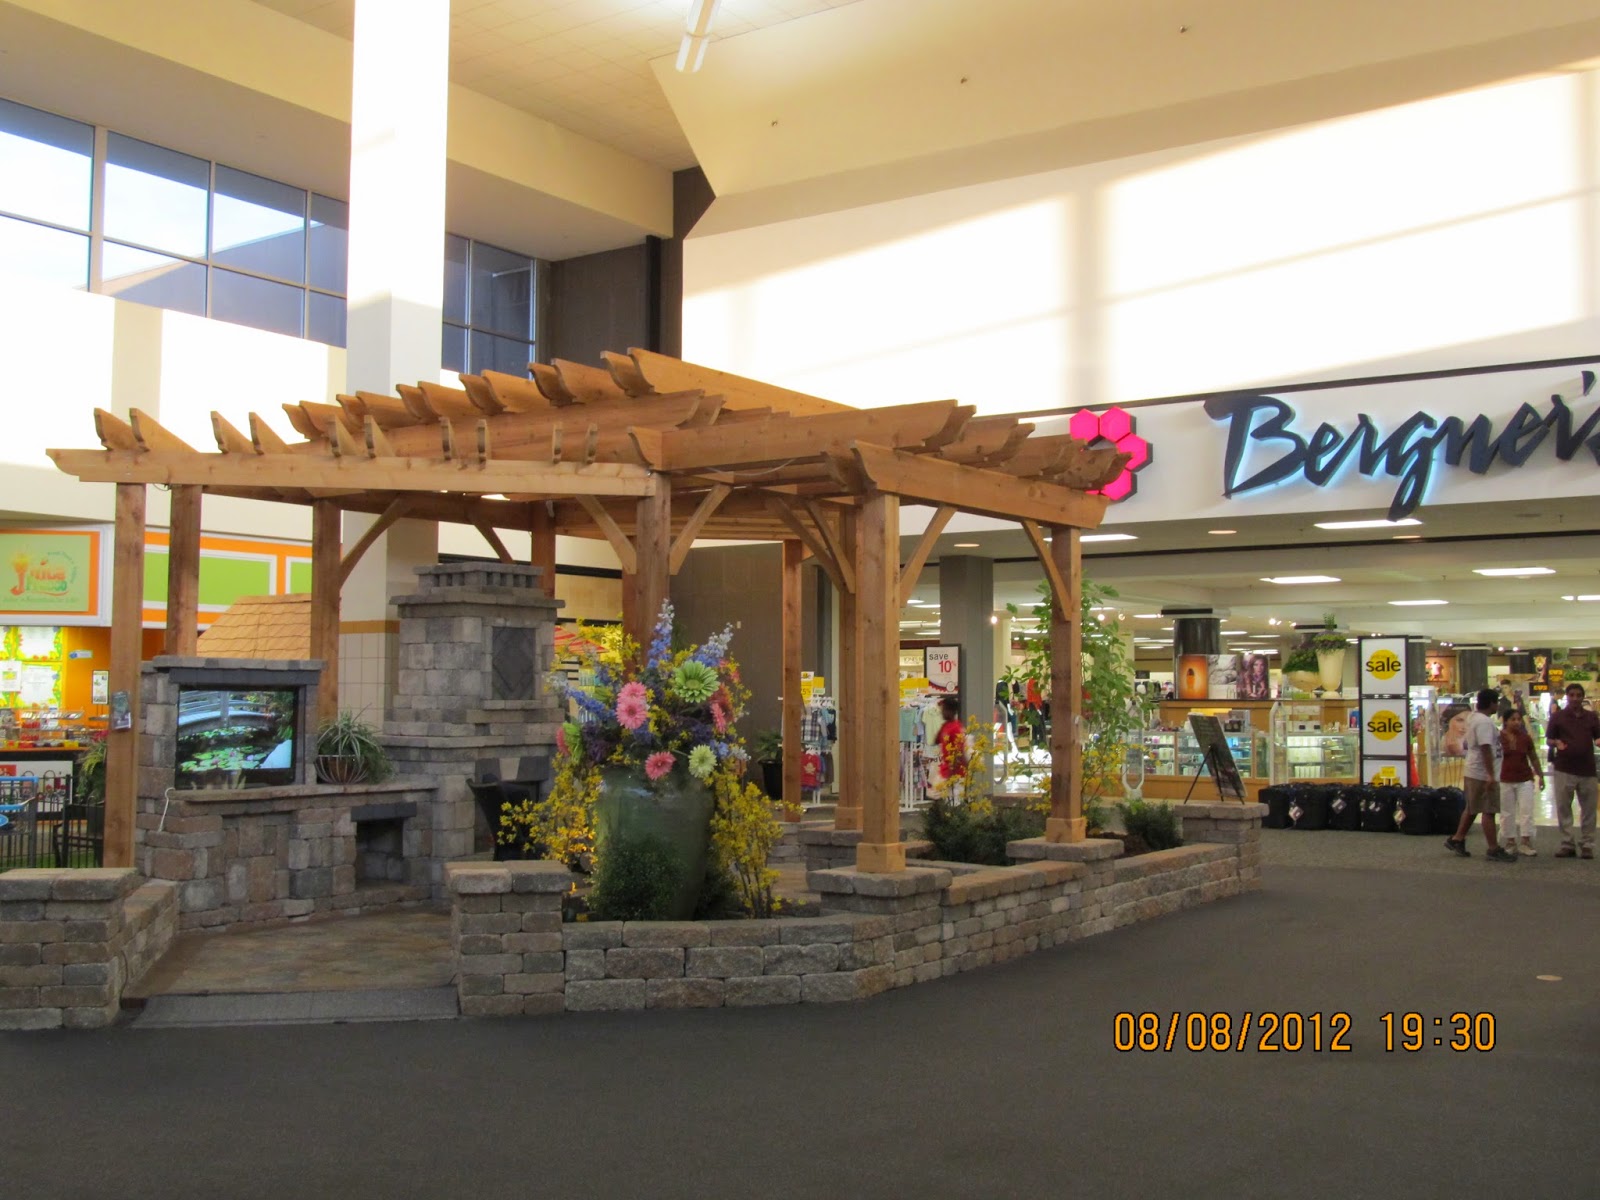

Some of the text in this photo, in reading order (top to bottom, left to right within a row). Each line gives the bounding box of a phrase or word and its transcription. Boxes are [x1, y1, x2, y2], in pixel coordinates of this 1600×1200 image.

[928, 653, 949, 661] save
[1365, 656, 1402, 672] sale
[1366, 717, 1403, 733] sale
